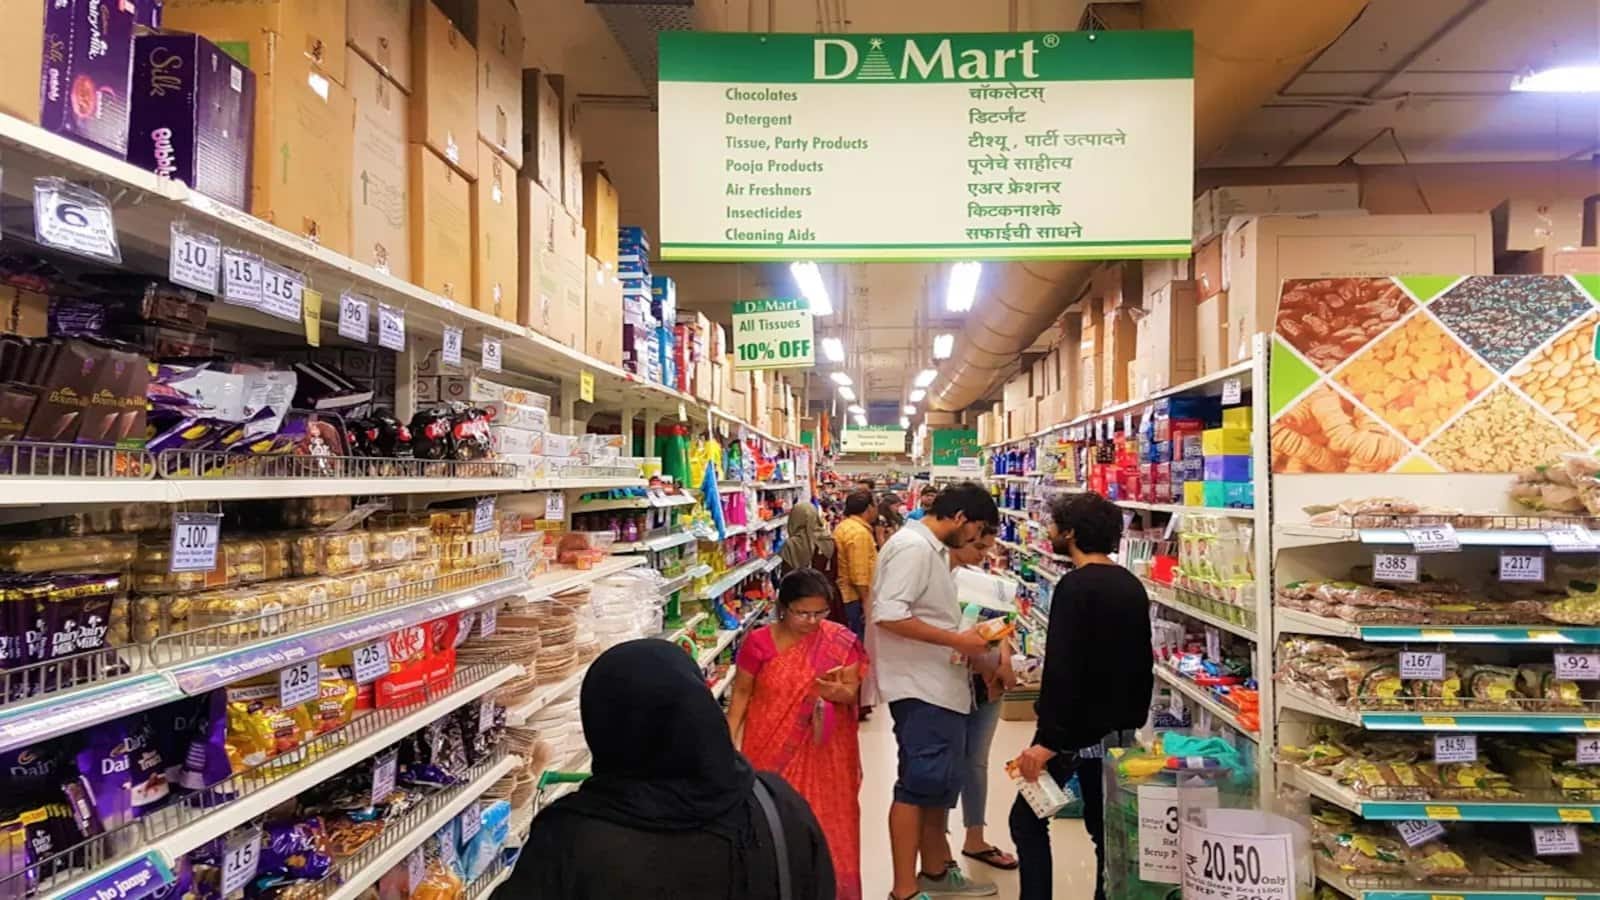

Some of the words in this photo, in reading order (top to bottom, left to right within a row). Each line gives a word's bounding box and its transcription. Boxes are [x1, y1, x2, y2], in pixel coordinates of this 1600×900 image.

[150, 47, 183, 96] Silk
[725, 87, 798, 101] Chocolates
[969, 82, 1046, 103] चॉकलेटस्
[725, 112, 792, 128] Detergent
[725, 136, 770, 150] Tissue,
[775, 137, 808, 152] Party
[813, 136, 869, 150] Products
[1025, 129, 1060, 147] पार्टी
[1063, 128, 1127, 146] उत्पादने
[726, 159, 763, 174] Pooja
[768, 159, 824, 172] Products
[968, 153, 1009, 175] पूजेचे
[1014, 152, 1073, 172] साहीत्य
[725, 183, 745, 196] Air
[749, 183, 812, 196] Freshners
[968, 182, 1003, 197] एअर
[1008, 177, 1062, 194] फ्रेशनर
[56, 203, 88, 227] 6
[726, 206, 802, 219] Insecticides
[968, 200, 1062, 218] किटकनाशके
[725, 228, 784, 245] Cleaning
[788, 228, 816, 241] Aids
[966, 222, 1032, 241] सफाईची
[1037, 221, 1083, 239] साधने
[739, 319, 755, 331] All
[759, 318, 800, 330] Tissues
[737, 342, 775, 361] 10%
[779, 339, 810, 358] OFF
[1261, 876, 1286, 886] Only
